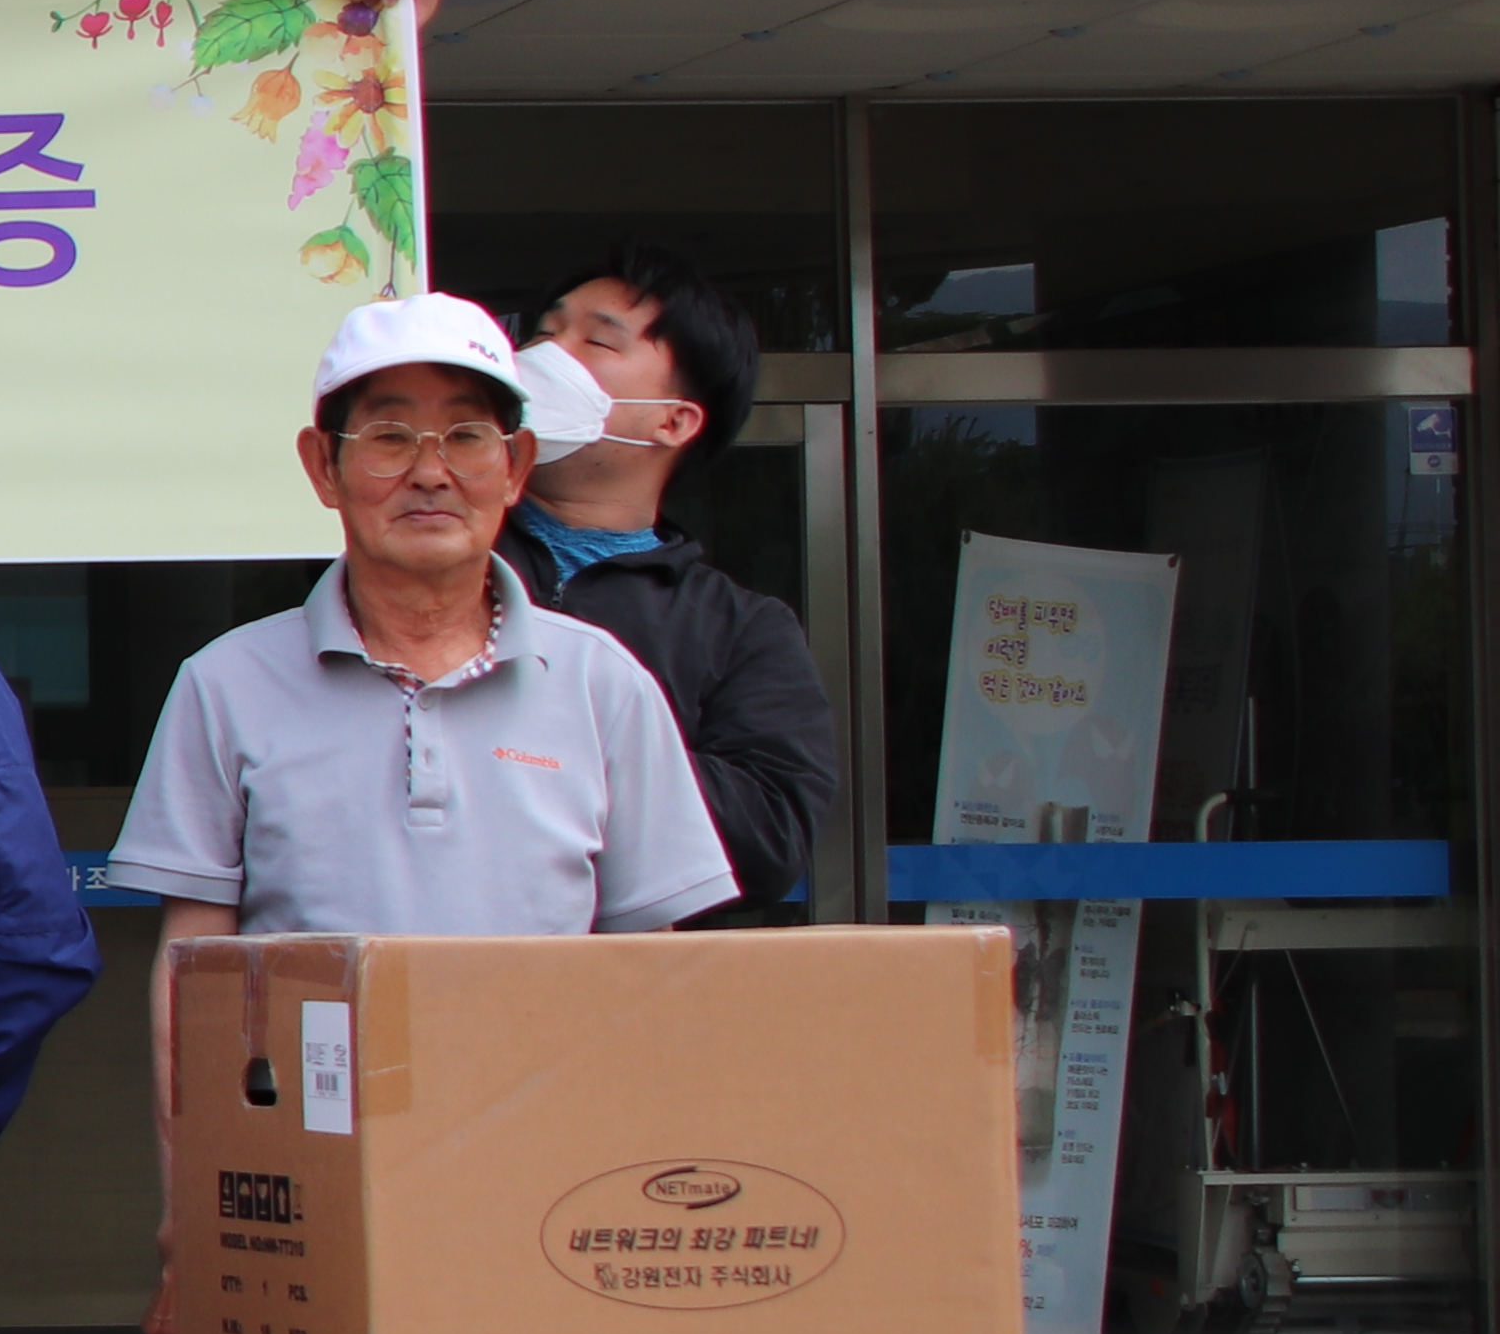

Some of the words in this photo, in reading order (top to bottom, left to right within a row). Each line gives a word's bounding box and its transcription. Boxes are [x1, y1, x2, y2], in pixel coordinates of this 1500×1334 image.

[988, 598, 1028, 631] 담배를
[1033, 605, 1075, 633] 피우면
[983, 675, 1008, 698] 먹는
[1017, 677, 1042, 699] 것과
[505, 749, 561, 769] Columbia
